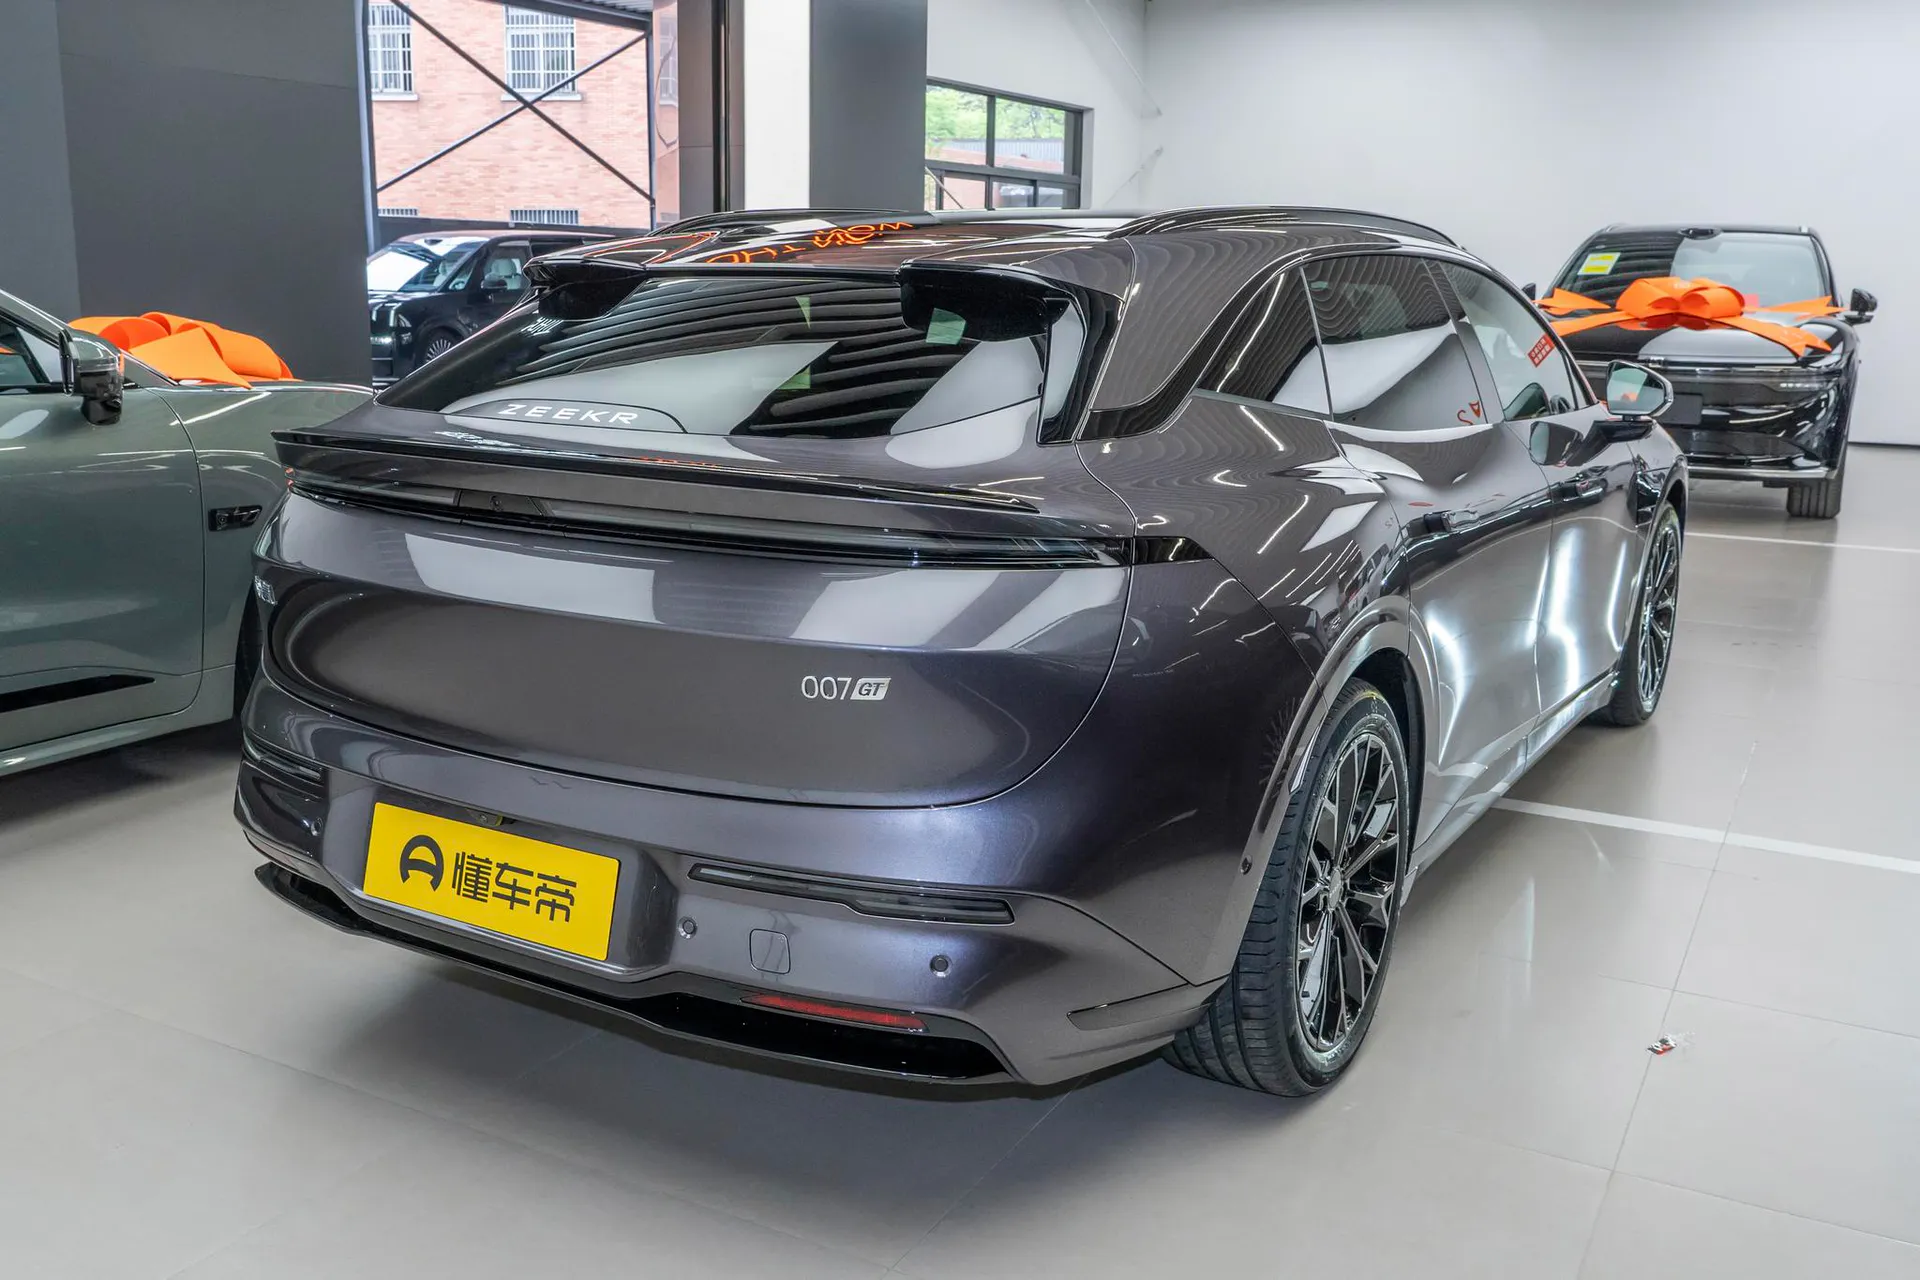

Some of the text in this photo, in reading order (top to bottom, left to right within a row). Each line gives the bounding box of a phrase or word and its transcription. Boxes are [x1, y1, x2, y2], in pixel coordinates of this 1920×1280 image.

[498, 403, 638, 425] ZEEKR
[801, 675, 888, 700] 007 GT
[451, 851, 578, 923] 懂车帝
